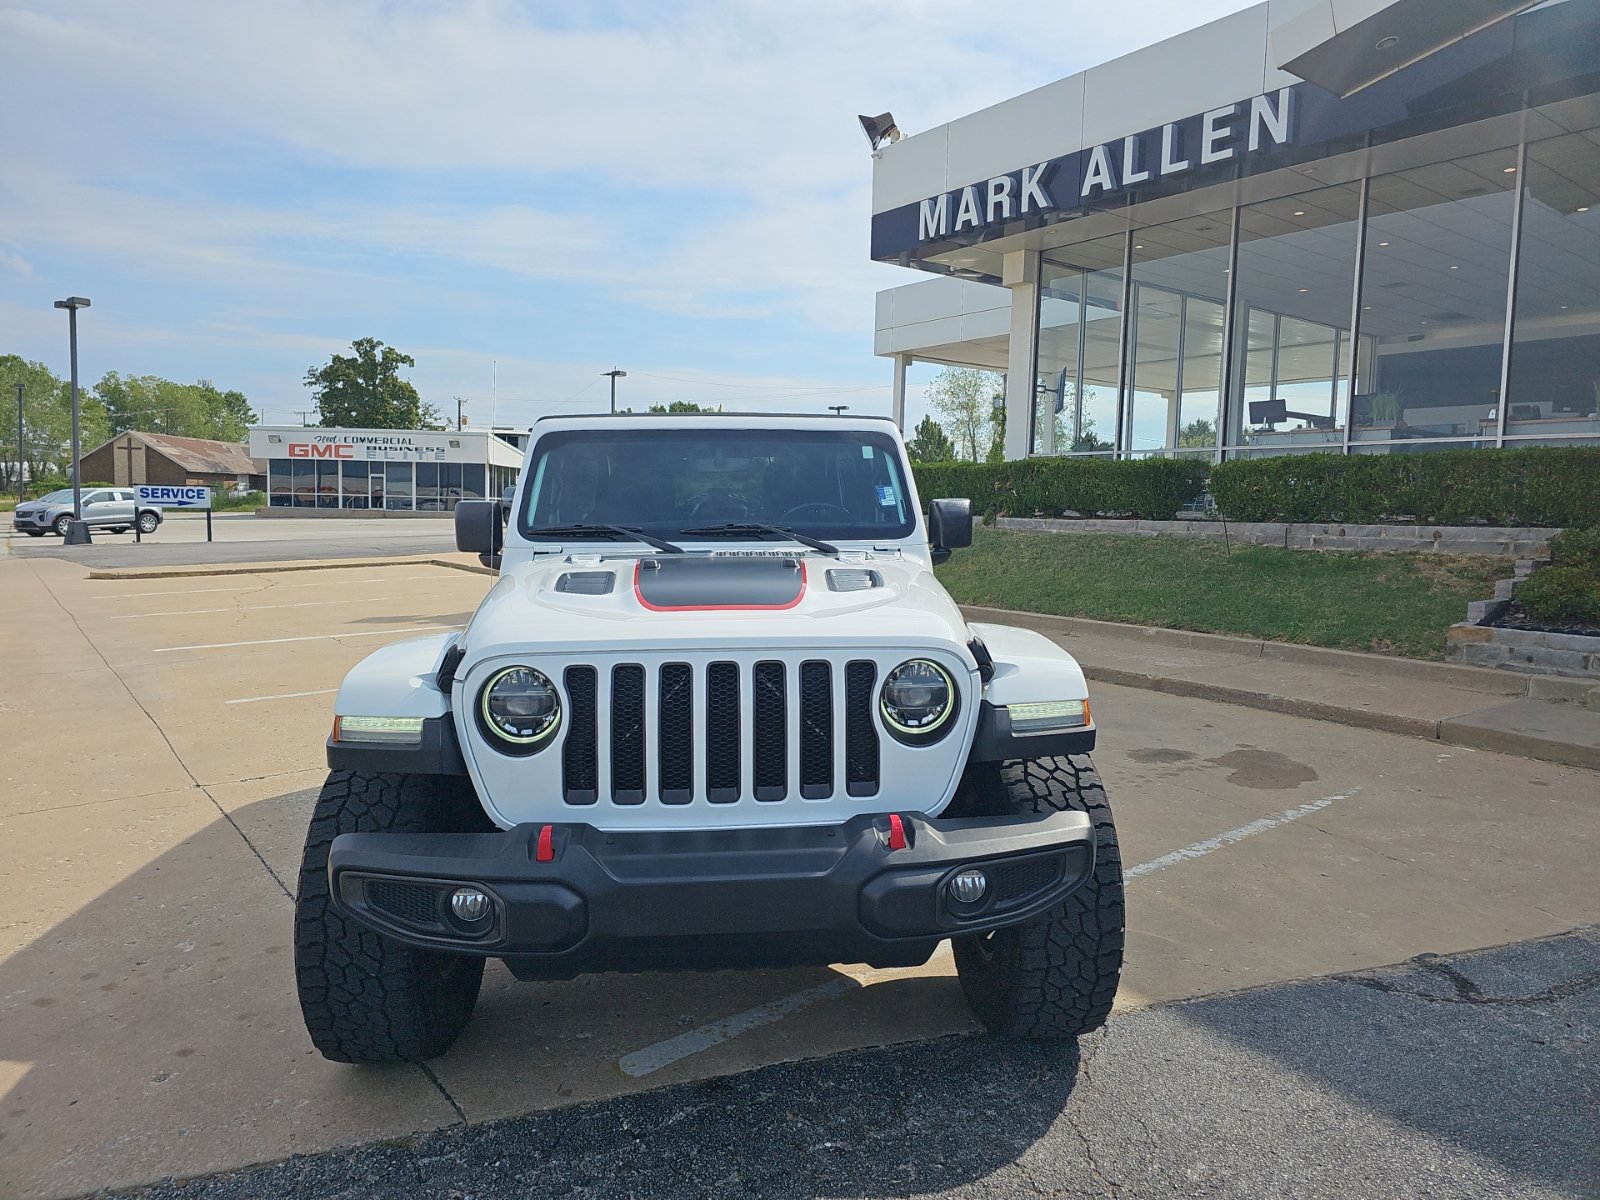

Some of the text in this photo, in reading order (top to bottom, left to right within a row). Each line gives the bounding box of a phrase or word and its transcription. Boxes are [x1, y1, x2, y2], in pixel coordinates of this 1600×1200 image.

[918, 87, 1295, 241] MARK ALLEN
[344, 436, 415, 445] COMMERCIAL
[289, 444, 353, 459] GMC
[366, 451, 445, 460] ELITE
[140, 488, 205, 499] SERVICE
